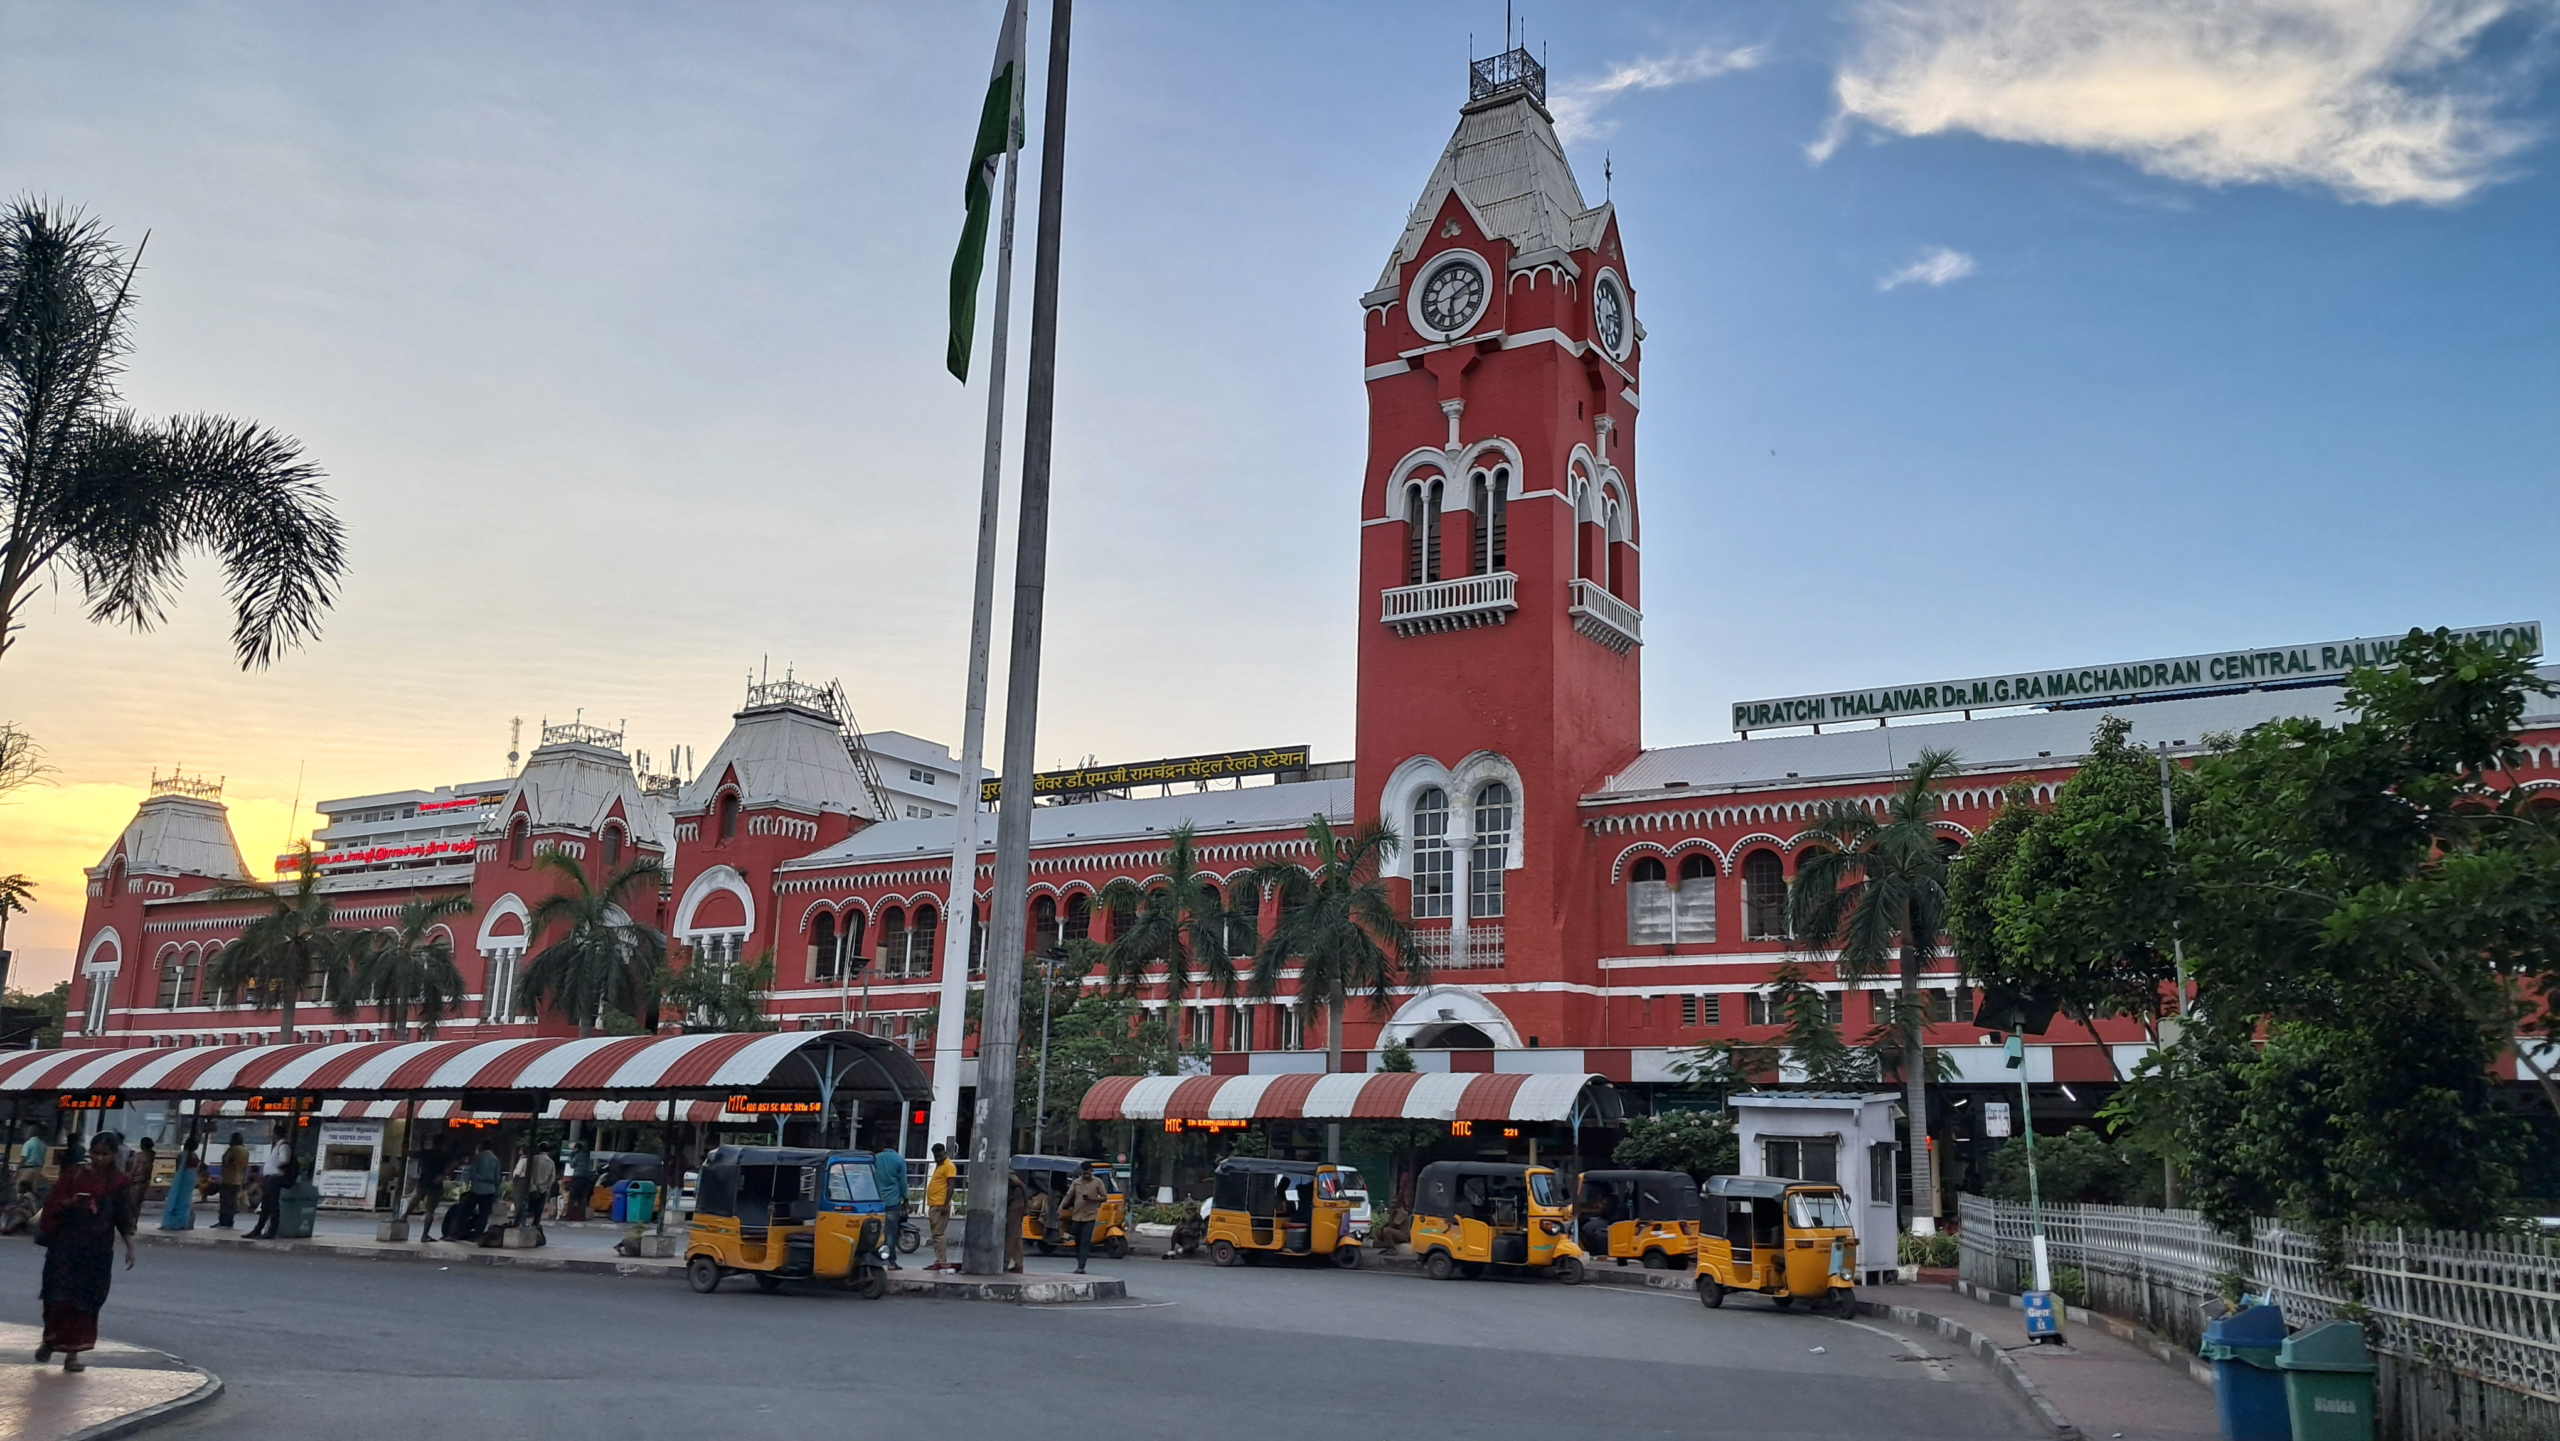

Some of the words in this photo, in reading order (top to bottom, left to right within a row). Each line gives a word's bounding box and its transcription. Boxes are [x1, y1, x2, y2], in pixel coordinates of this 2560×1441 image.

[1735, 697, 1825, 727] PURATCHI
[1830, 686, 1937, 717] THALAIVAR
[2209, 649, 2317, 681] CENTRAL
[1223, 752, 1260, 772] रेलवे
[1260, 750, 1306, 768] स्टेशन
[727, 1095, 748, 1112] MTC
[1164, 1118, 1183, 1133] MTC
[1451, 1121, 1473, 1136] MTC
[1503, 1128, 1519, 1137] 221
[339, 1134, 357, 1142] KEEPER
